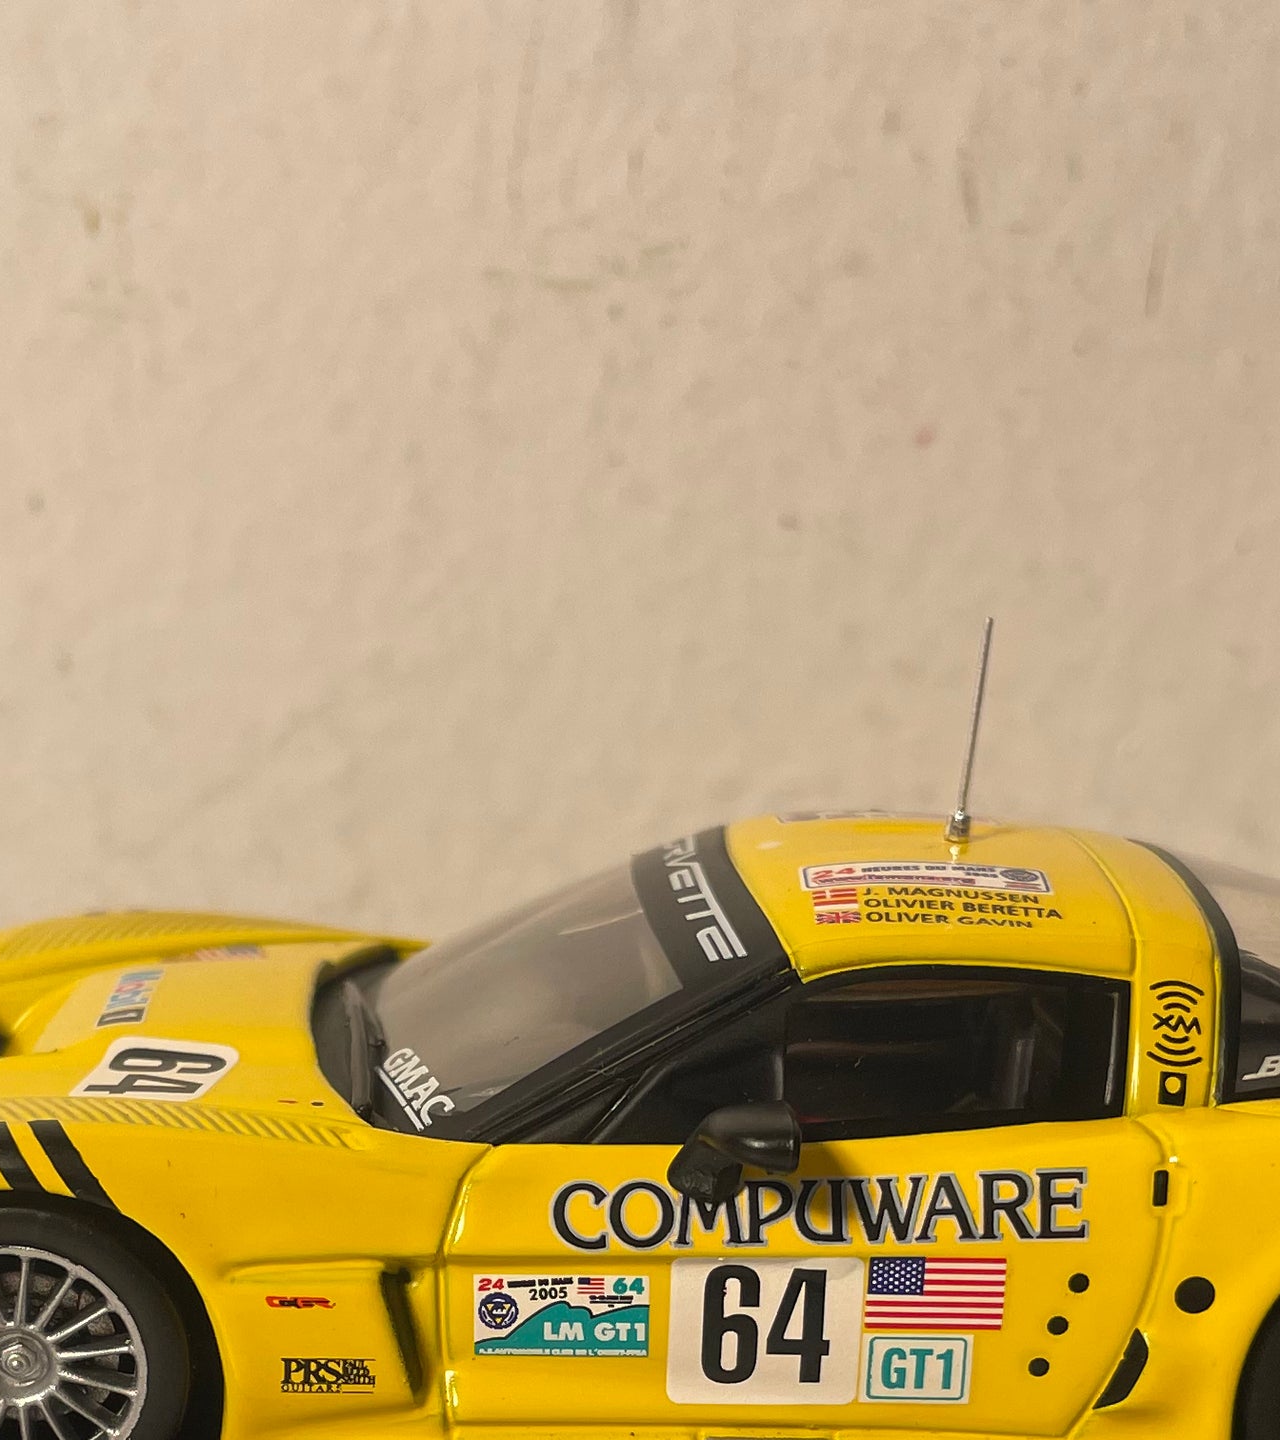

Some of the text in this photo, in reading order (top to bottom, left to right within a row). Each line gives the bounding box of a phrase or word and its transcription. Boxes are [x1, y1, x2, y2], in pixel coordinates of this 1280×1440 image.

[811, 867, 857, 881] 24
[888, 886, 1040, 905] MAGNUSSEN
[863, 898, 1063, 920] OLIVIER BERETTA
[865, 911, 1033, 929] OLIVER GAVIN
[1152, 1012, 1202, 1036] XM
[83, 1047, 227, 1095] 64
[381, 1046, 457, 1129] GMAC
[550, 1166, 1091, 1252] COMPUWARE
[477, 1277, 505, 1292] 24
[528, 1286, 568, 1301] 2005
[612, 1277, 645, 1295] 64
[543, 1321, 585, 1342] LM
[701, 1265, 830, 1385] 64
[281, 1358, 342, 1385] PRS
[880, 1345, 955, 1391] GT1
